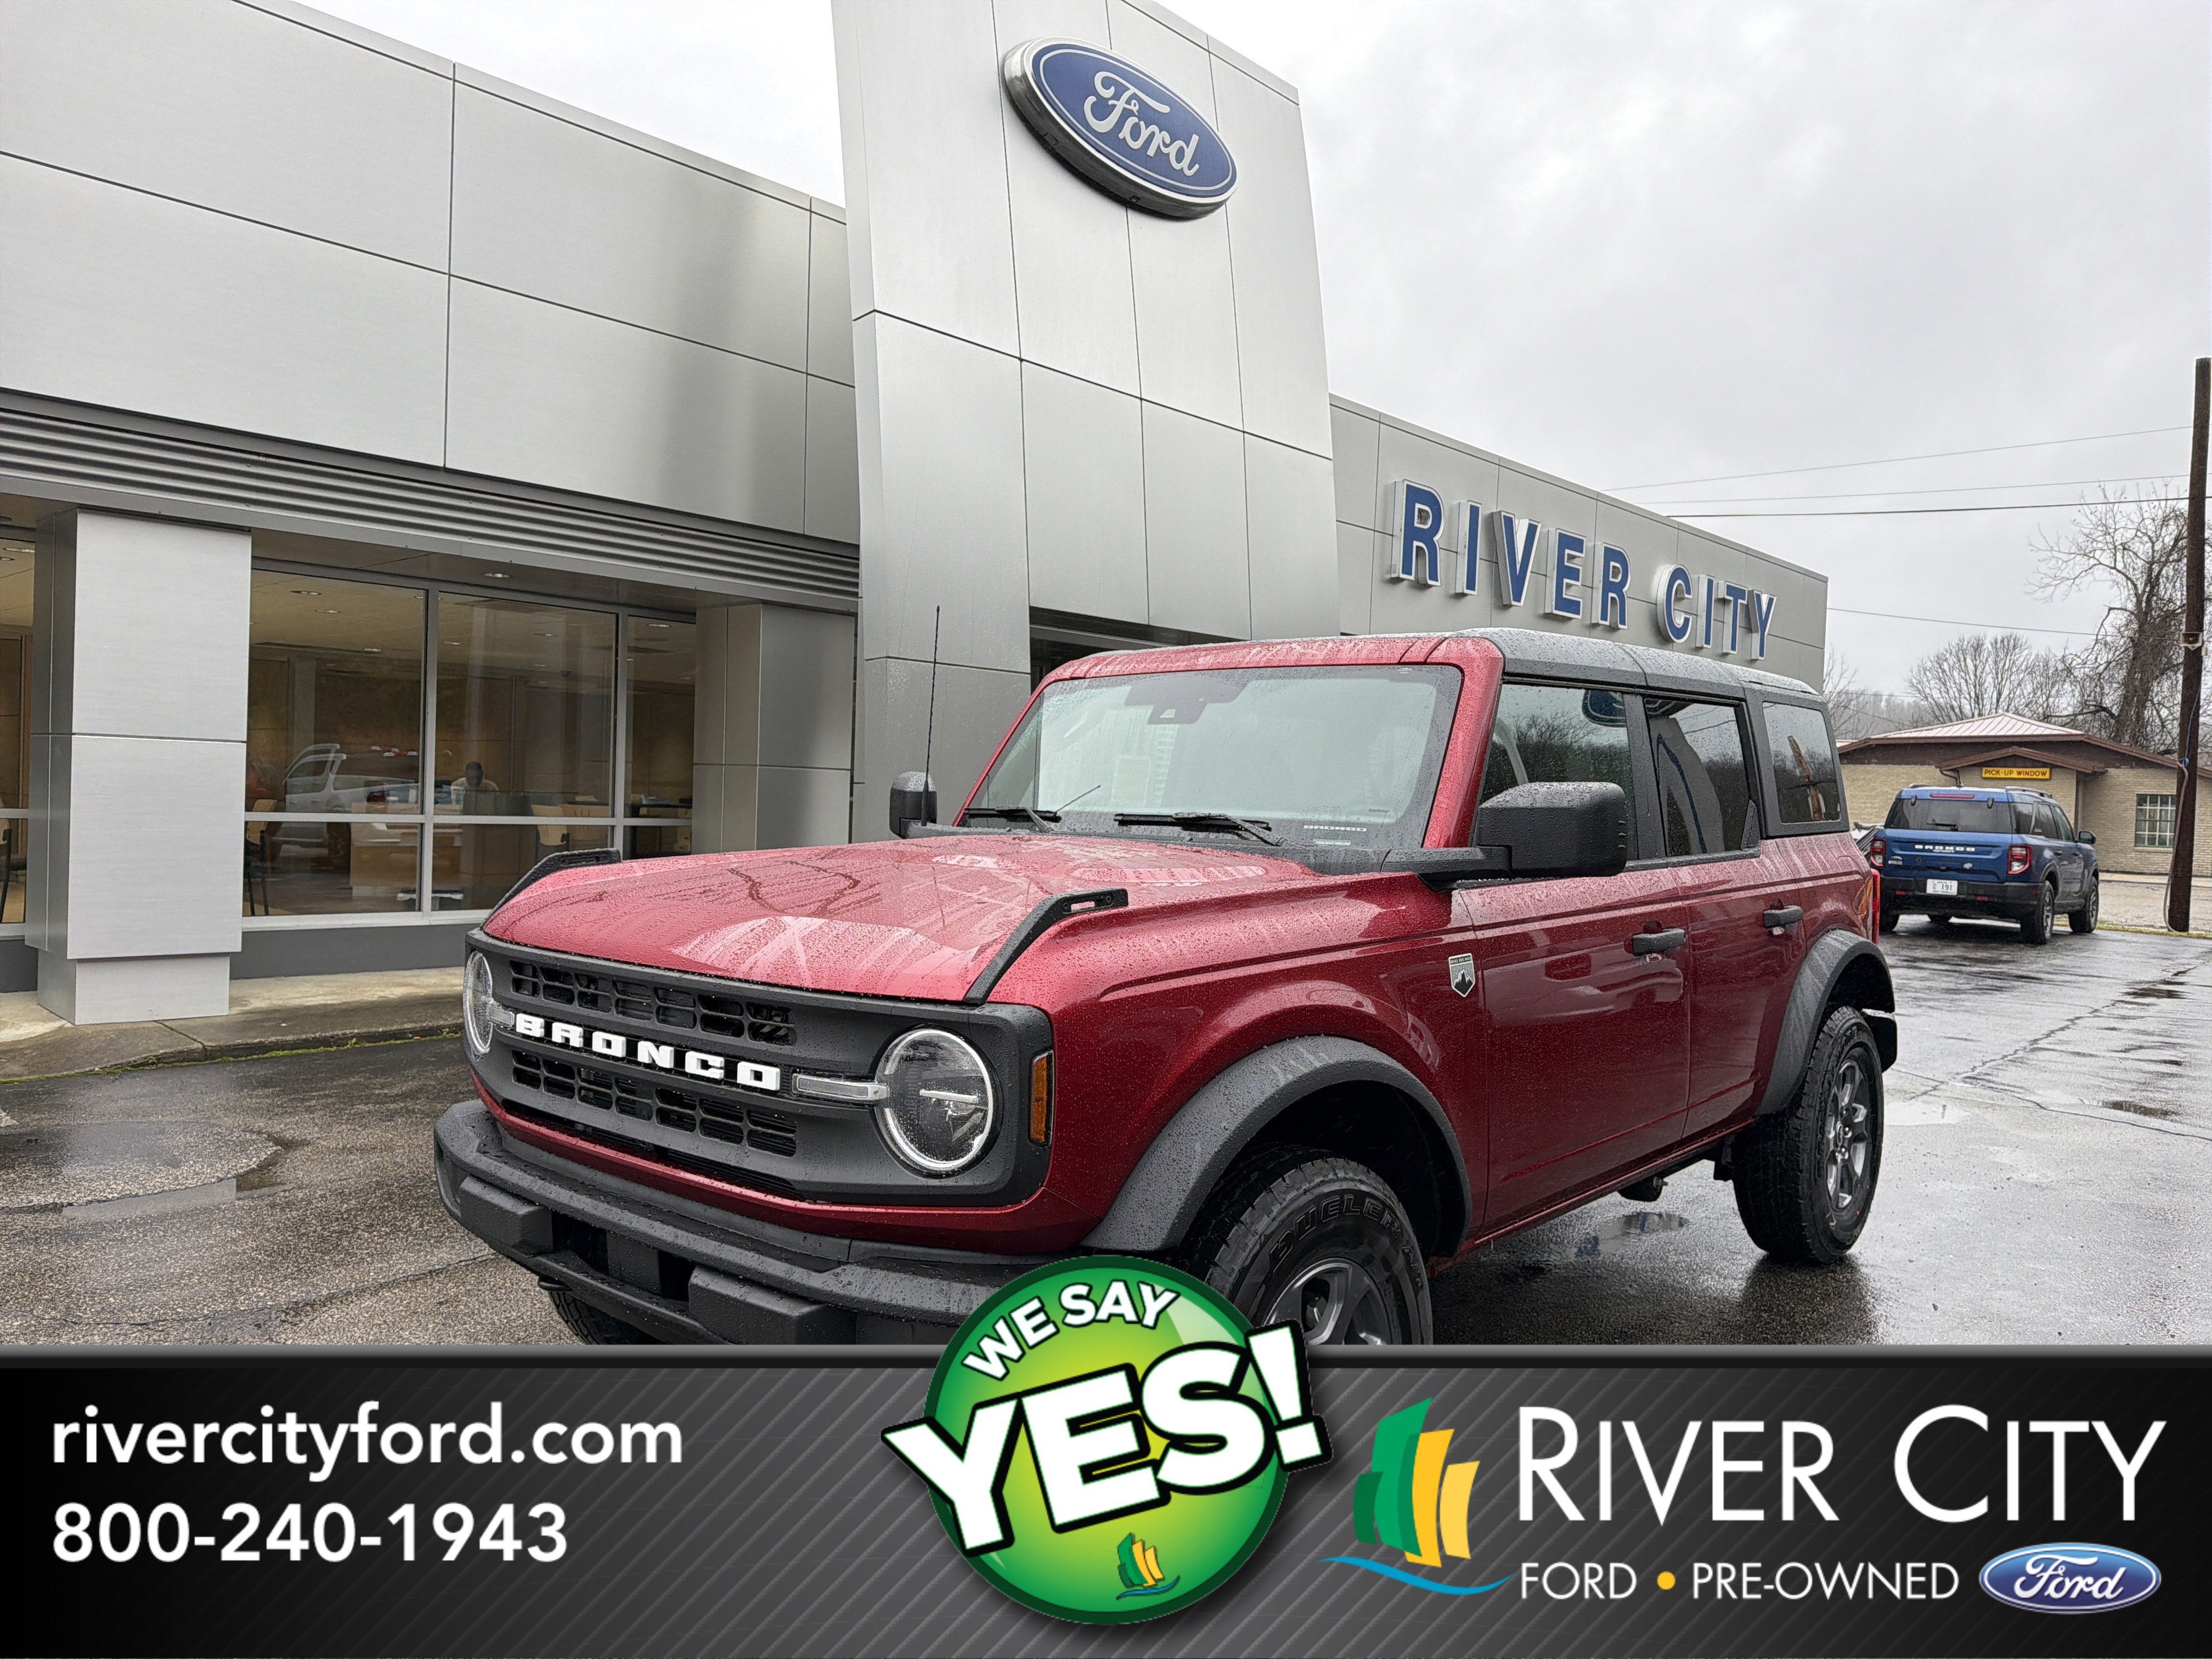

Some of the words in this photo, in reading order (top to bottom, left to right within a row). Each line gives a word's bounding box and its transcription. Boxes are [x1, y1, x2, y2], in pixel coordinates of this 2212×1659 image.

[1084, 71, 1200, 177] Ford
[1390, 478, 1632, 630] RIVER
[1657, 563, 1778, 661] CITY
[515, 1012, 781, 1091] BRONCO
